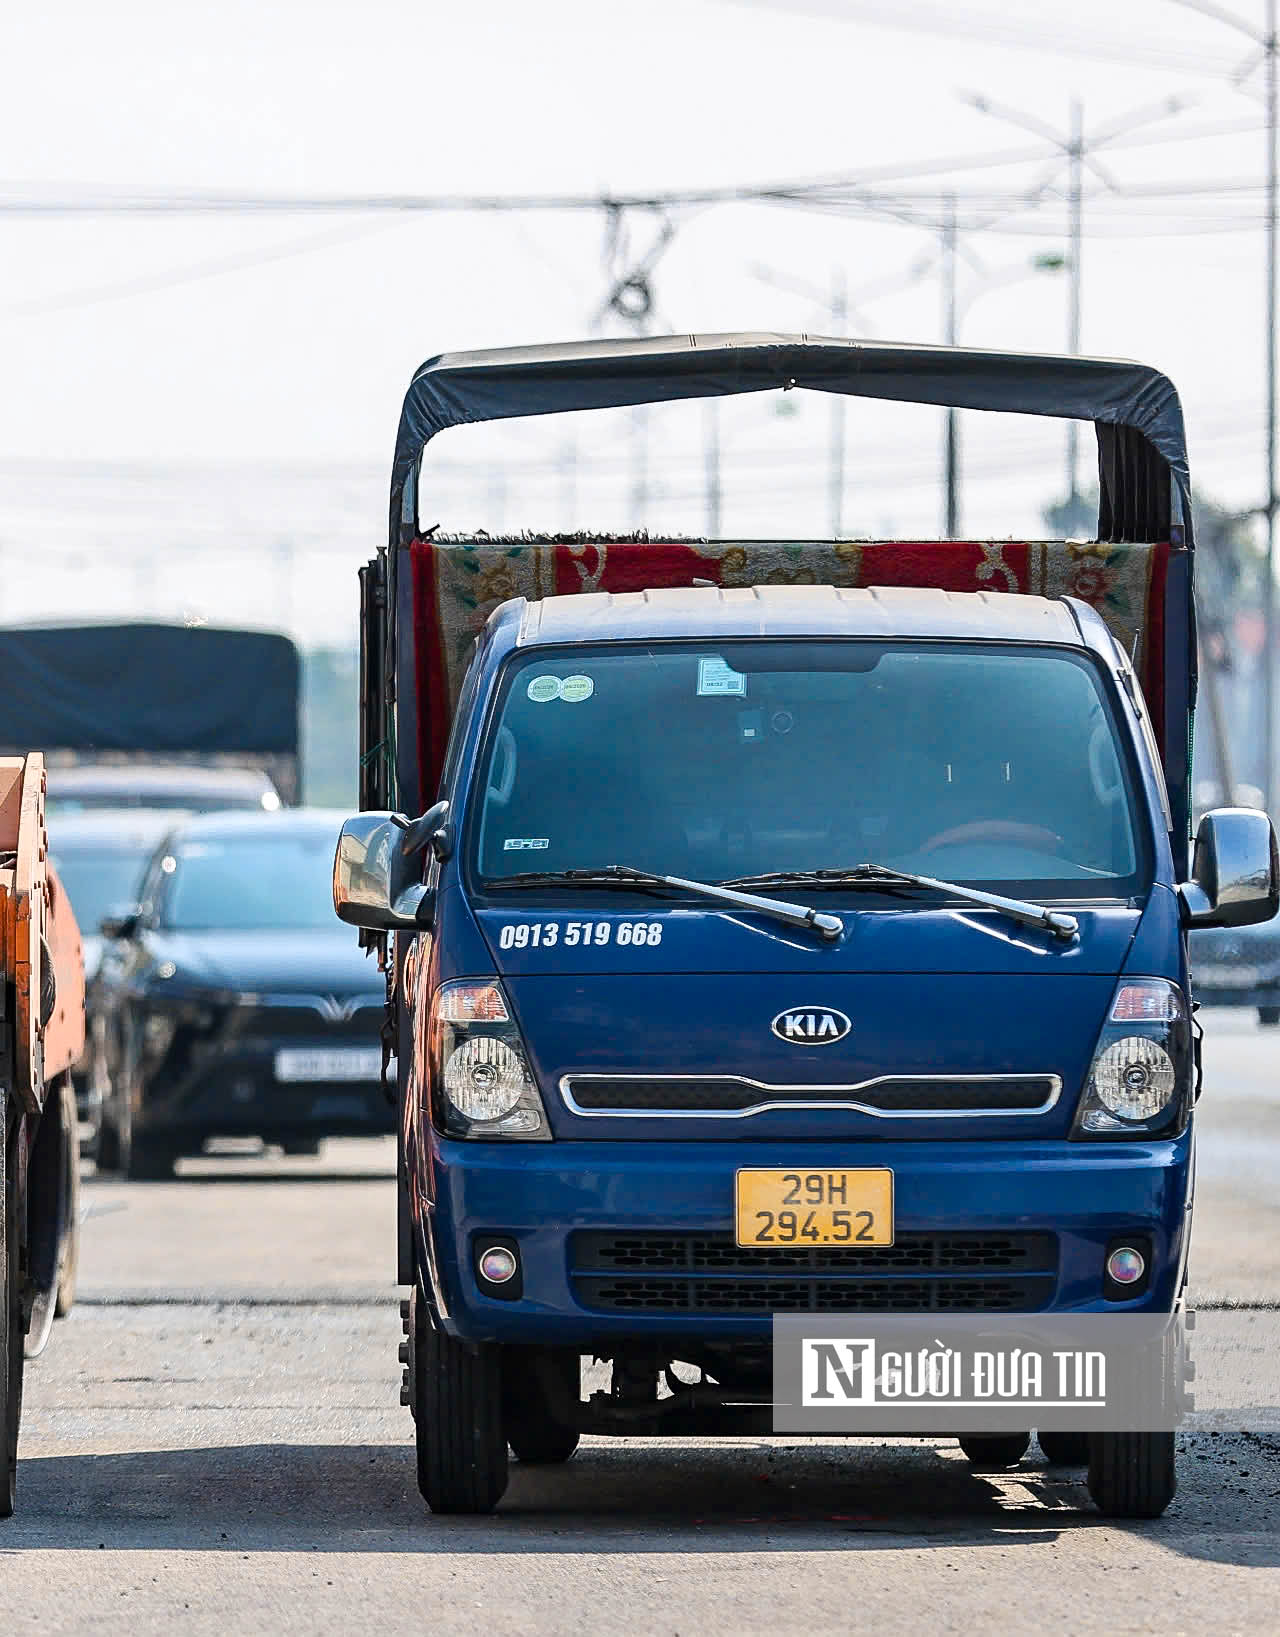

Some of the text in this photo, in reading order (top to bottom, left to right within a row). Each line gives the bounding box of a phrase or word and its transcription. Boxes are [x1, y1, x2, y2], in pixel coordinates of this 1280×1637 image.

[499, 922, 663, 950] 0913 519 668
[784, 1014, 840, 1038] KIA
[783, 1174, 848, 1205] 29H
[754, 1210, 875, 1242] 294.52
